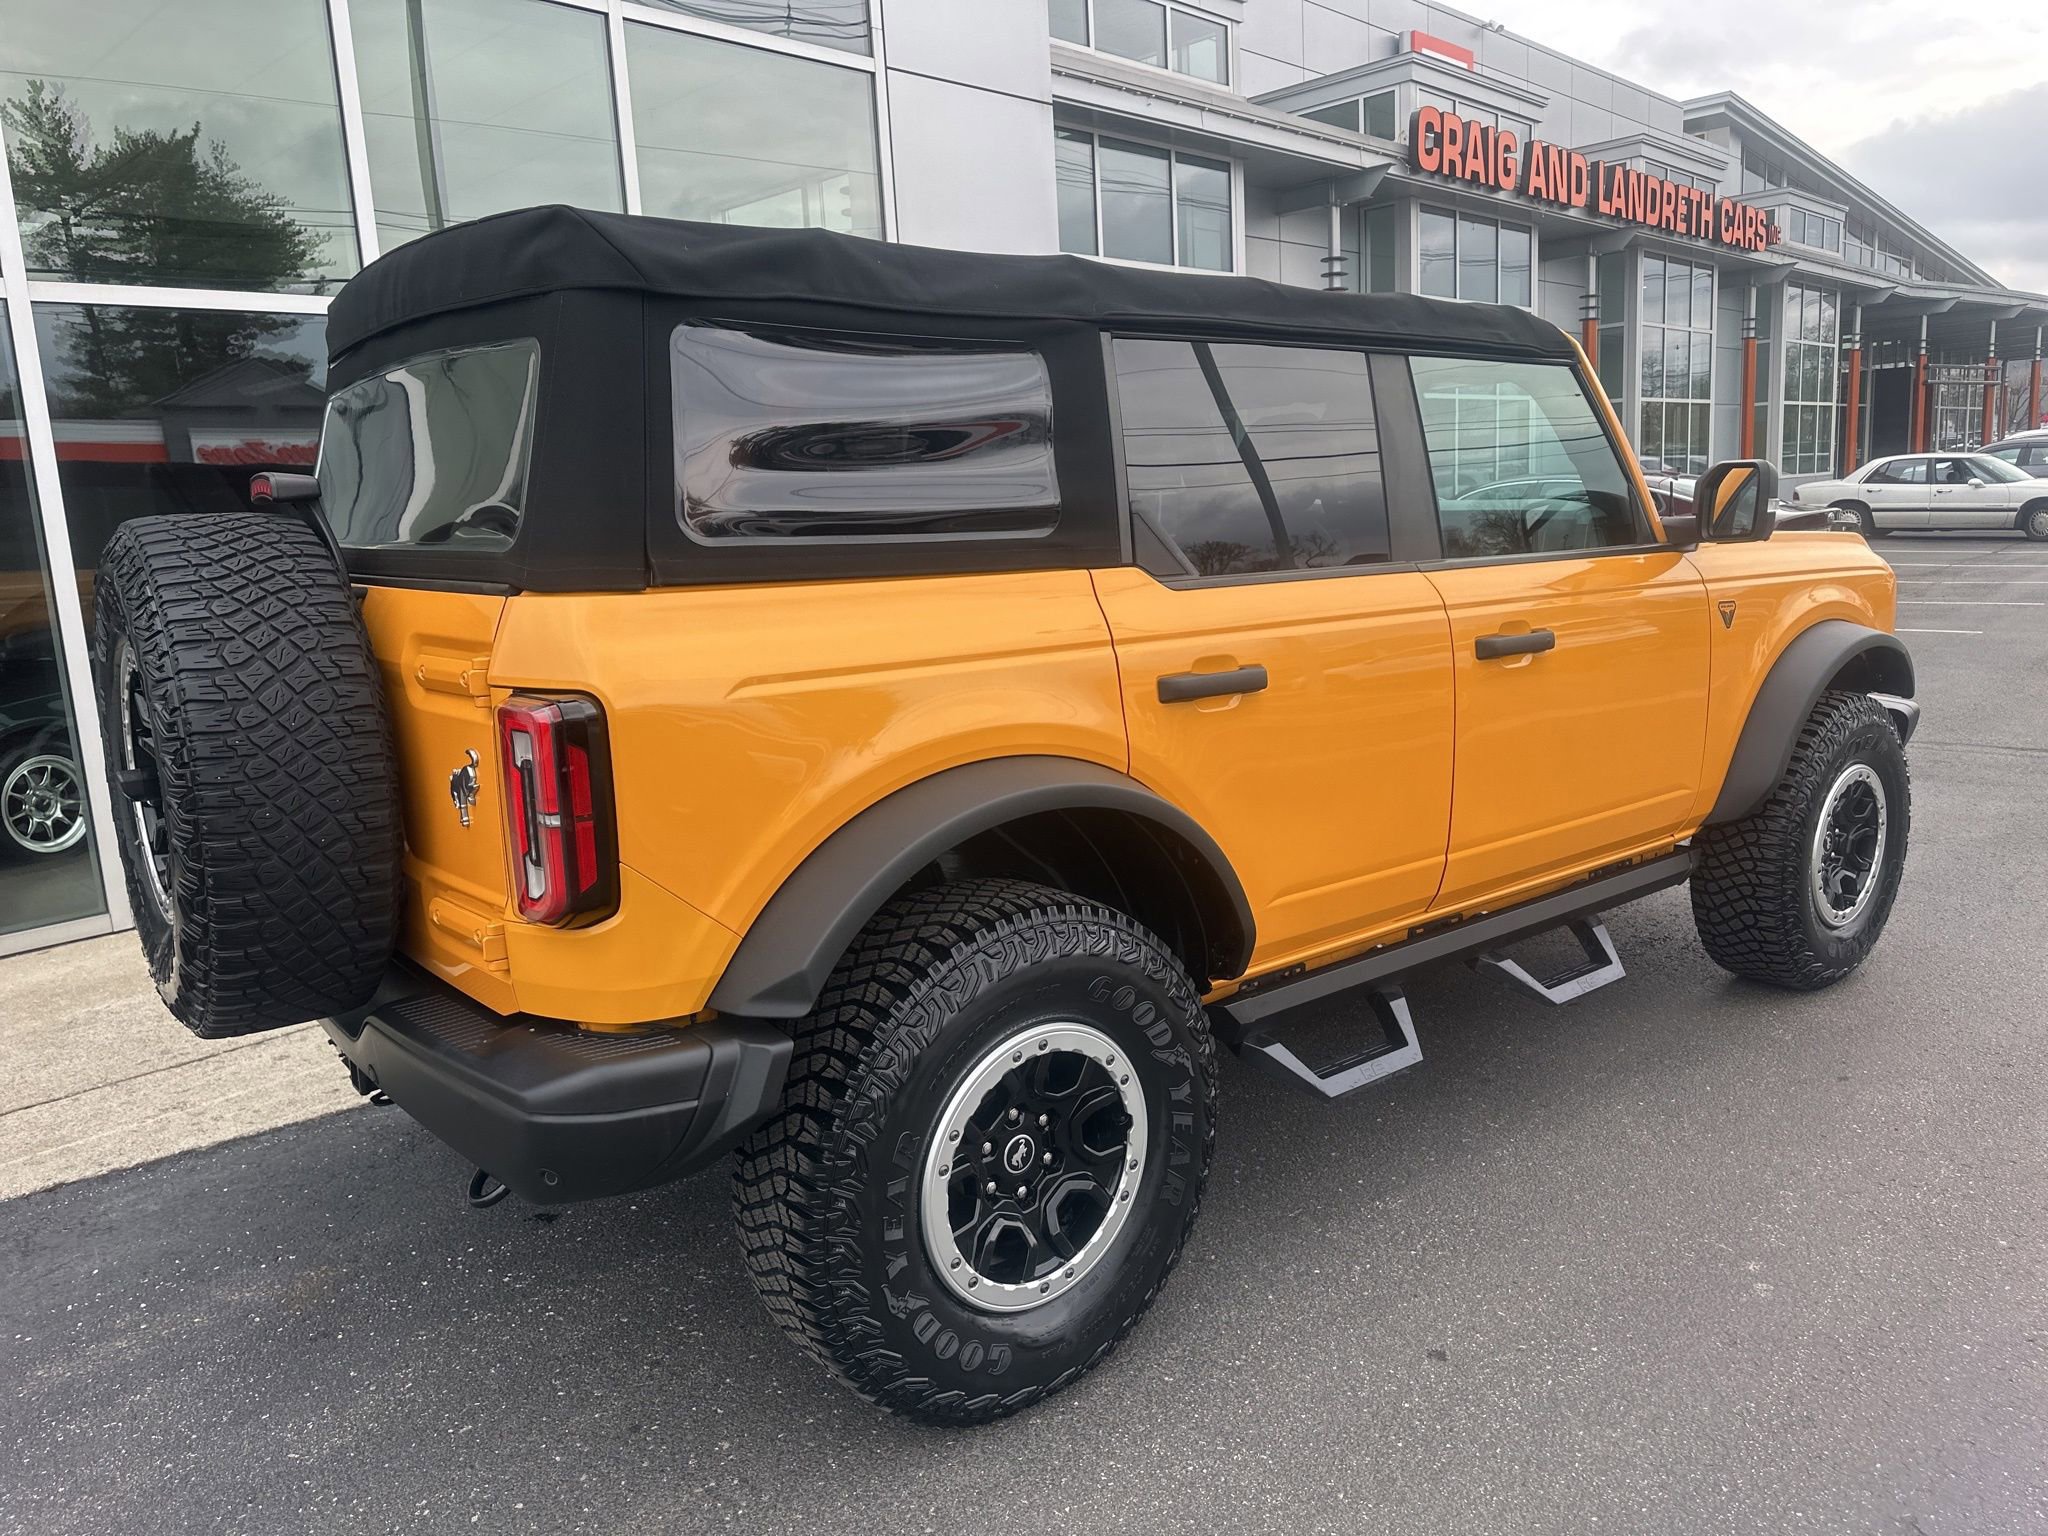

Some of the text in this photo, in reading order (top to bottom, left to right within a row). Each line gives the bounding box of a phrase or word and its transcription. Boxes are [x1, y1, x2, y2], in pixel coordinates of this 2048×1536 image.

[1414, 105, 1518, 192] CRAIG
[1525, 139, 1588, 208] AND
[1596, 160, 1715, 241] LANDRETH
[1719, 197, 1768, 253] CARS
